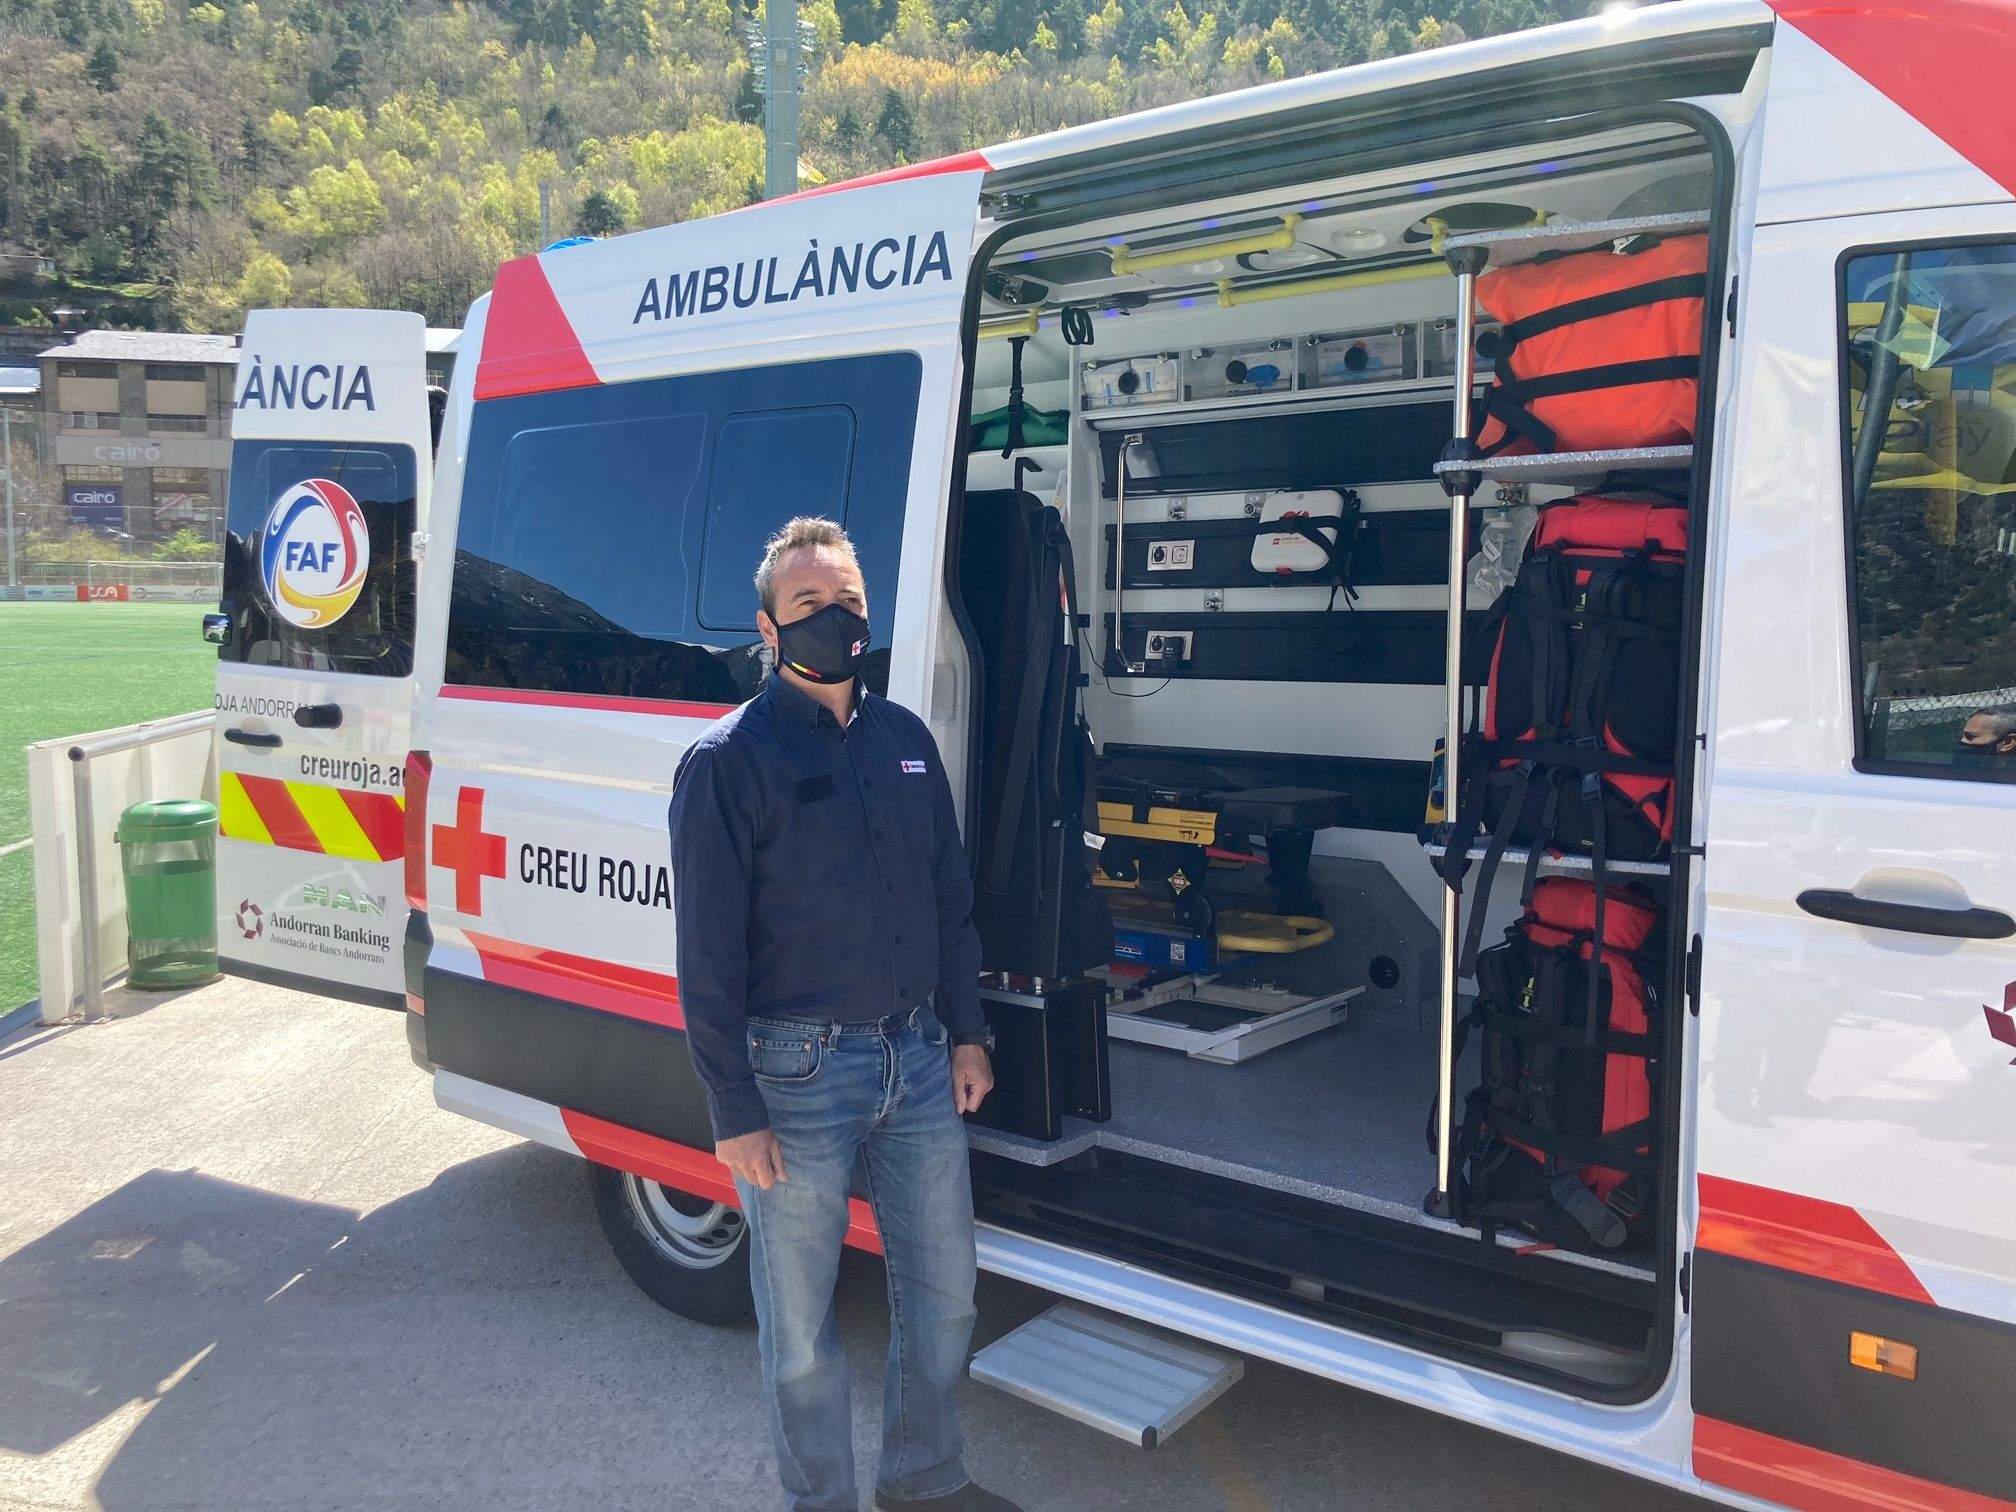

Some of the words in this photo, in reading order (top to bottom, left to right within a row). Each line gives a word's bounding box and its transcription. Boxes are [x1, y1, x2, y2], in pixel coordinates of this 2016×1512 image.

[632, 230, 953, 324] AMBULÀNCIA
[233, 354, 376, 411] ÀNCIA
[285, 541, 341, 573] FAF
[301, 755, 406, 788] creuroja.a
[520, 843, 588, 893] CREU
[598, 856, 672, 909] ROJA
[303, 883, 387, 917] MAN
[270, 912, 330, 938] Andorran
[334, 923, 390, 952] Banking
[308, 941, 318, 952] de
[320, 943, 342, 957] Bancs
[343, 947, 386, 964] Andorrans
